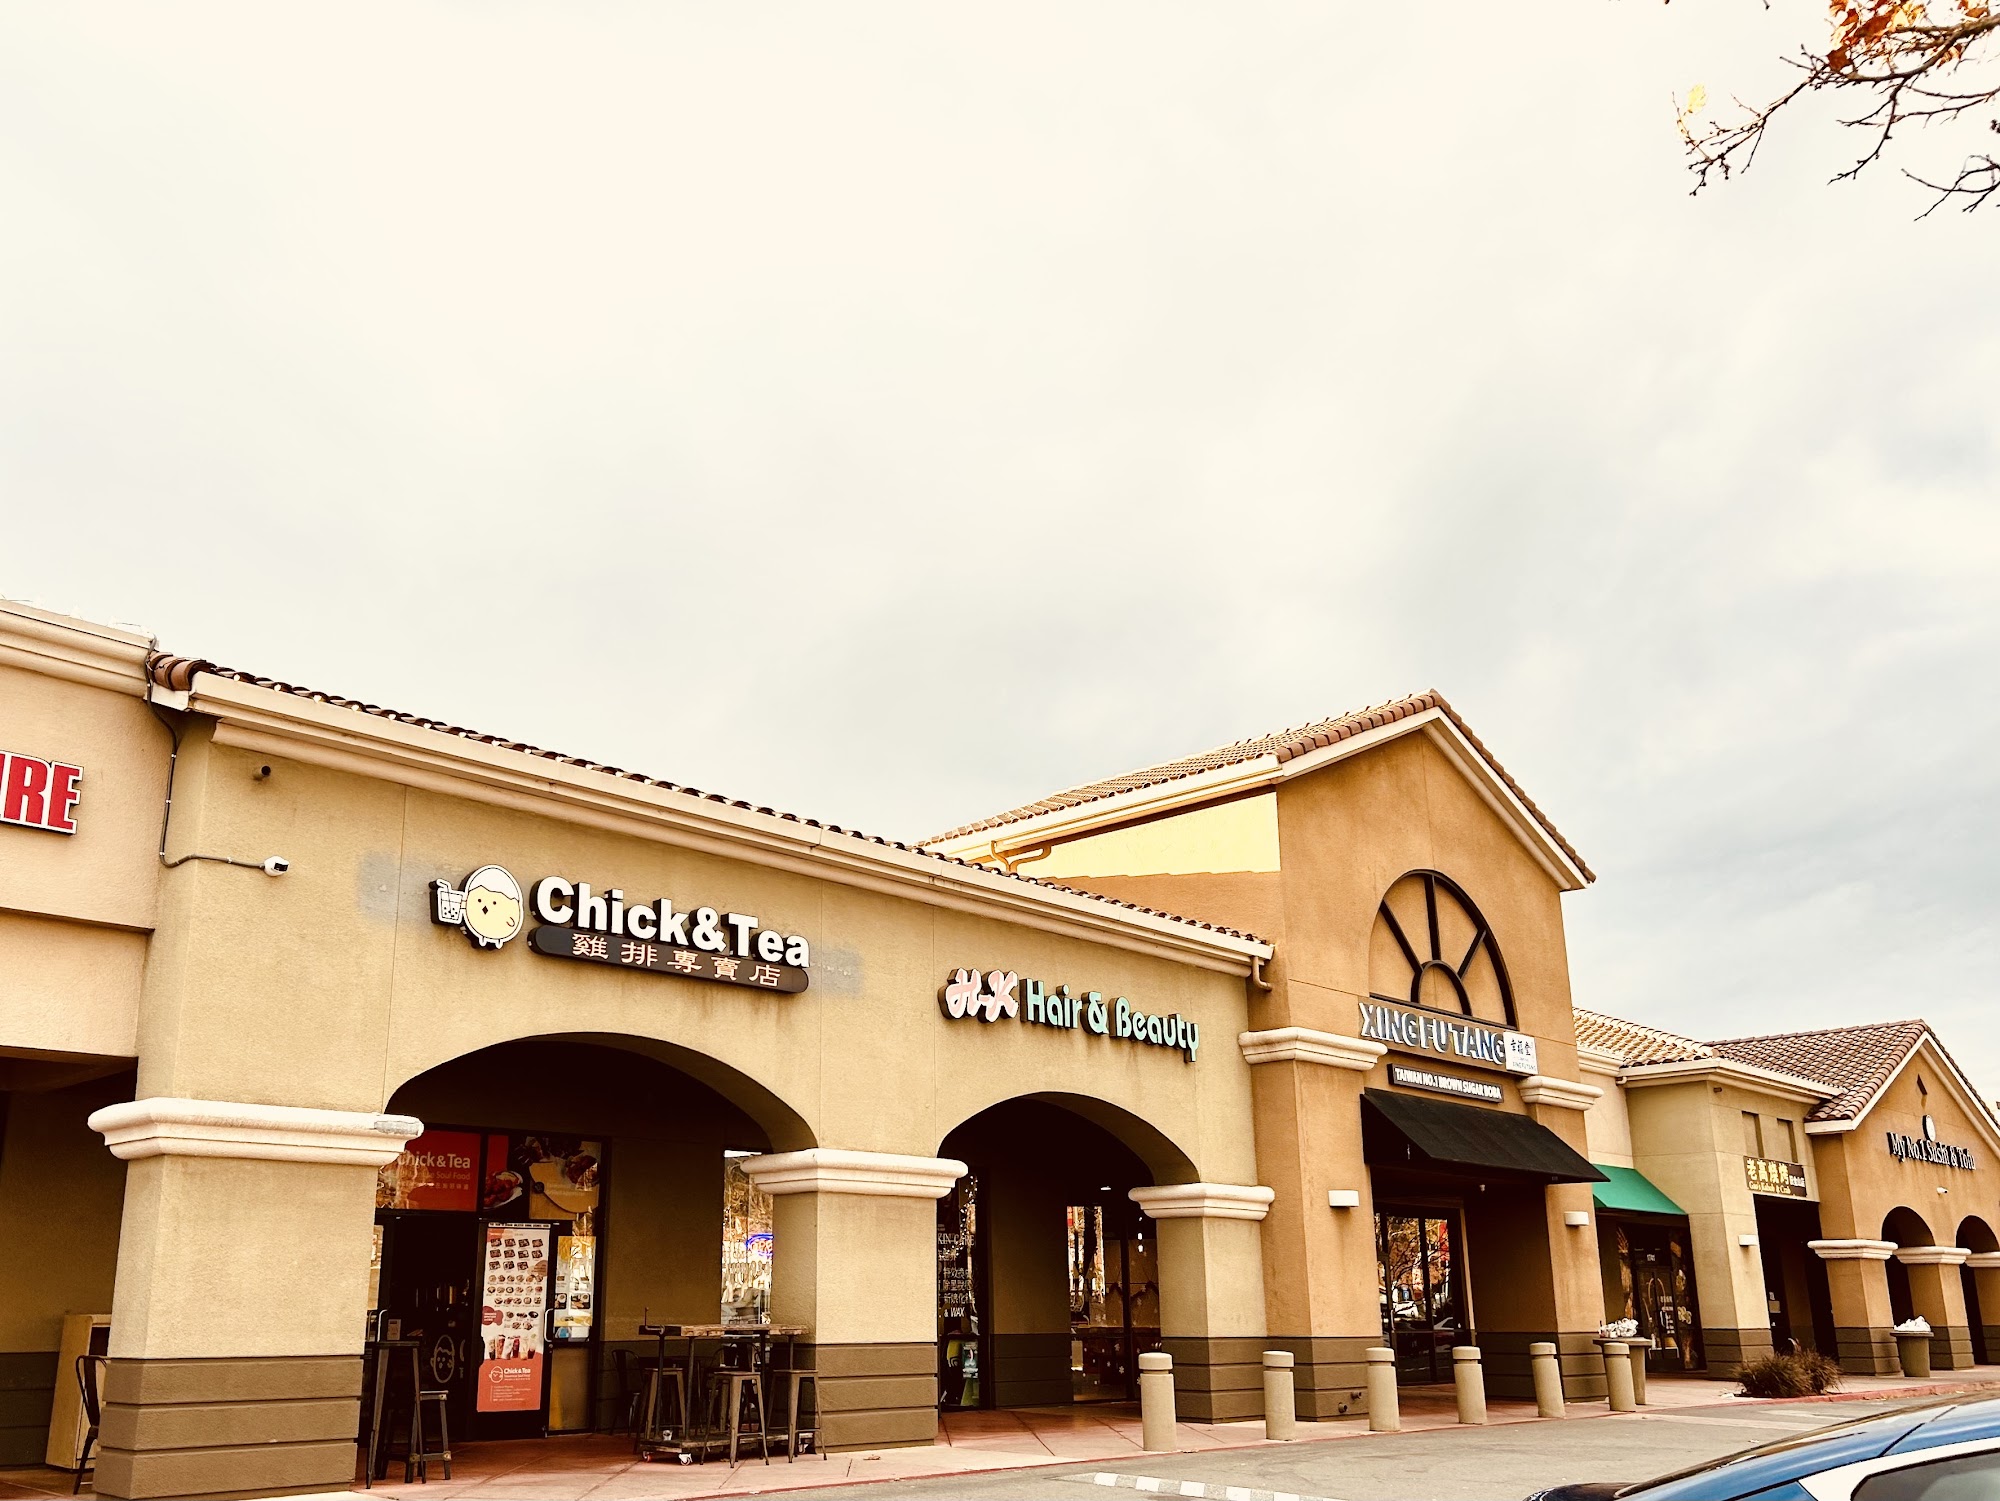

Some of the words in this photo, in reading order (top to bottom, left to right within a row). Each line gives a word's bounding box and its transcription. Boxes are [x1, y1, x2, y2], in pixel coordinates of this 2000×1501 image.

[0, 750, 84, 834] RE
[571, 933, 782, 988] 雞排專賣店
[1026, 978, 1082, 1029] Hair
[1087, 991, 1109, 1035] &
[1115, 996, 1200, 1062] Beauty
[1394, 1067, 1423, 1085] TAIWAN
[1422, 1072, 1439, 1088] NO.1
[1438, 1075, 1463, 1092] BROWN
[1462, 1080, 1485, 1096] SUGAR
[1890, 1132, 1906, 1163] My
[1906, 1136, 1927, 1161] No.1
[1926, 1140, 1951, 1166] Sushi
[1950, 1145, 1958, 1167] &
[1956, 1146, 1977, 1170] Tofu
[453, 1171, 471, 1180] Food
[937, 1233, 951, 1245] KIN
[950, 1307, 966, 1318] WAX
